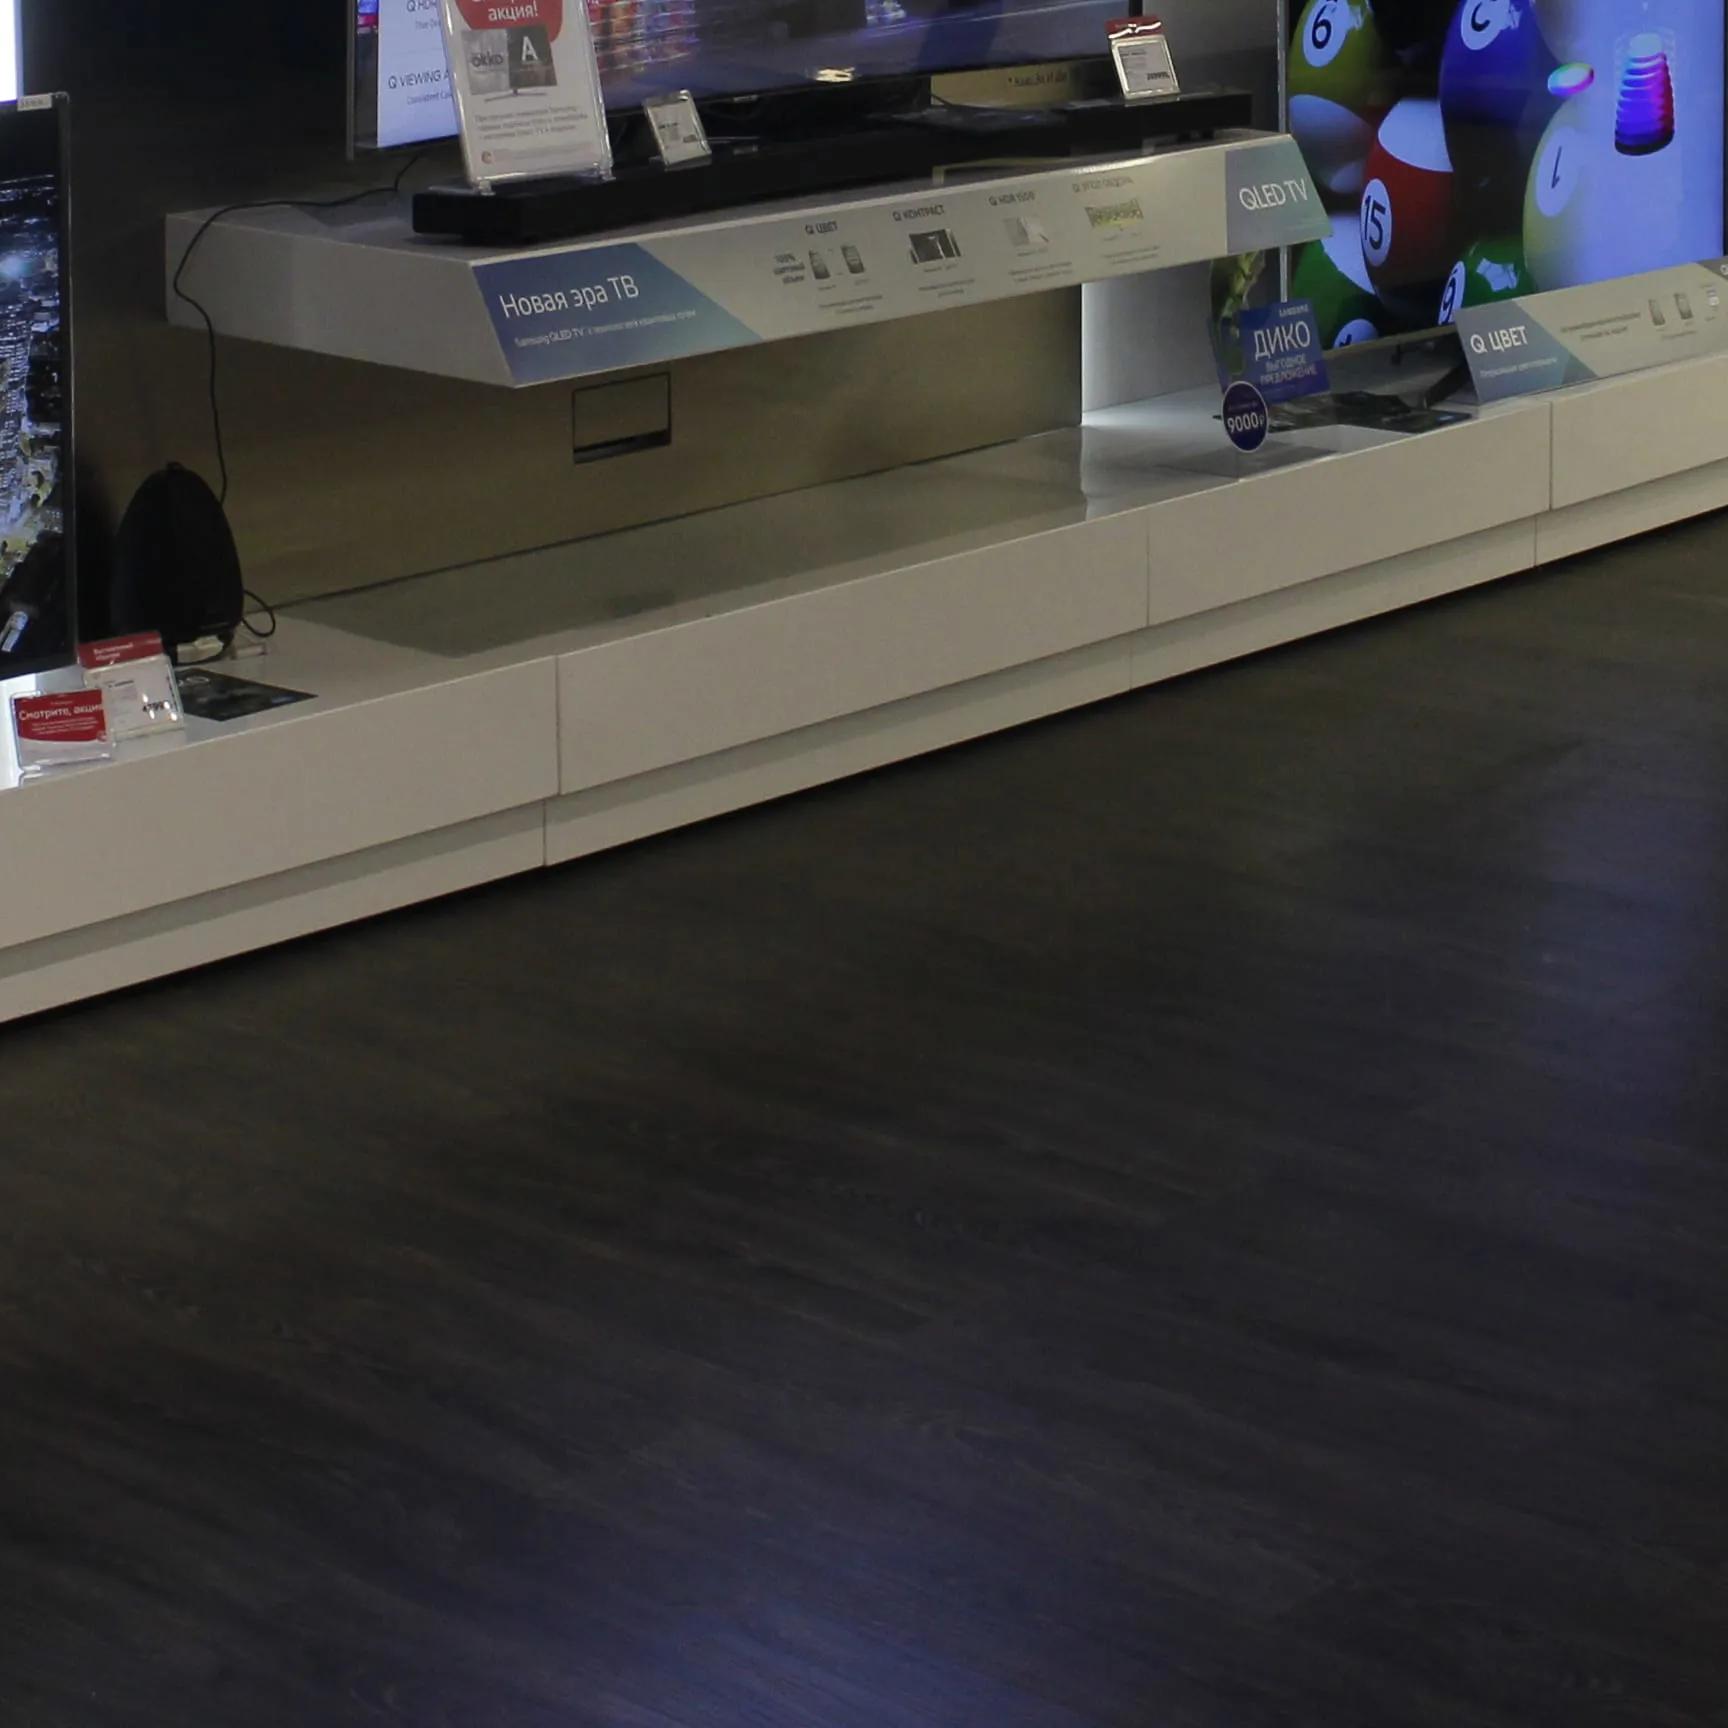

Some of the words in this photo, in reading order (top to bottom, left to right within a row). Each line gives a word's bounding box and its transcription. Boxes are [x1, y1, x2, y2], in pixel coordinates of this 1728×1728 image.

[487, 0, 539, 22] акция!
[399, 69, 442, 88] VIEWING
[1239, 183, 1287, 210] QLED
[1284, 178, 1308, 203] TV
[1364, 195, 1388, 251] 15
[499, 290, 569, 320] Новая
[570, 284, 609, 313] эра
[606, 274, 641, 301] ТВ
[1253, 321, 1311, 361] ДИКО
[1470, 334, 1488, 355] Q
[1490, 325, 1529, 353] ЦВЕТ
[18, 706, 72, 721] Смотрите,
